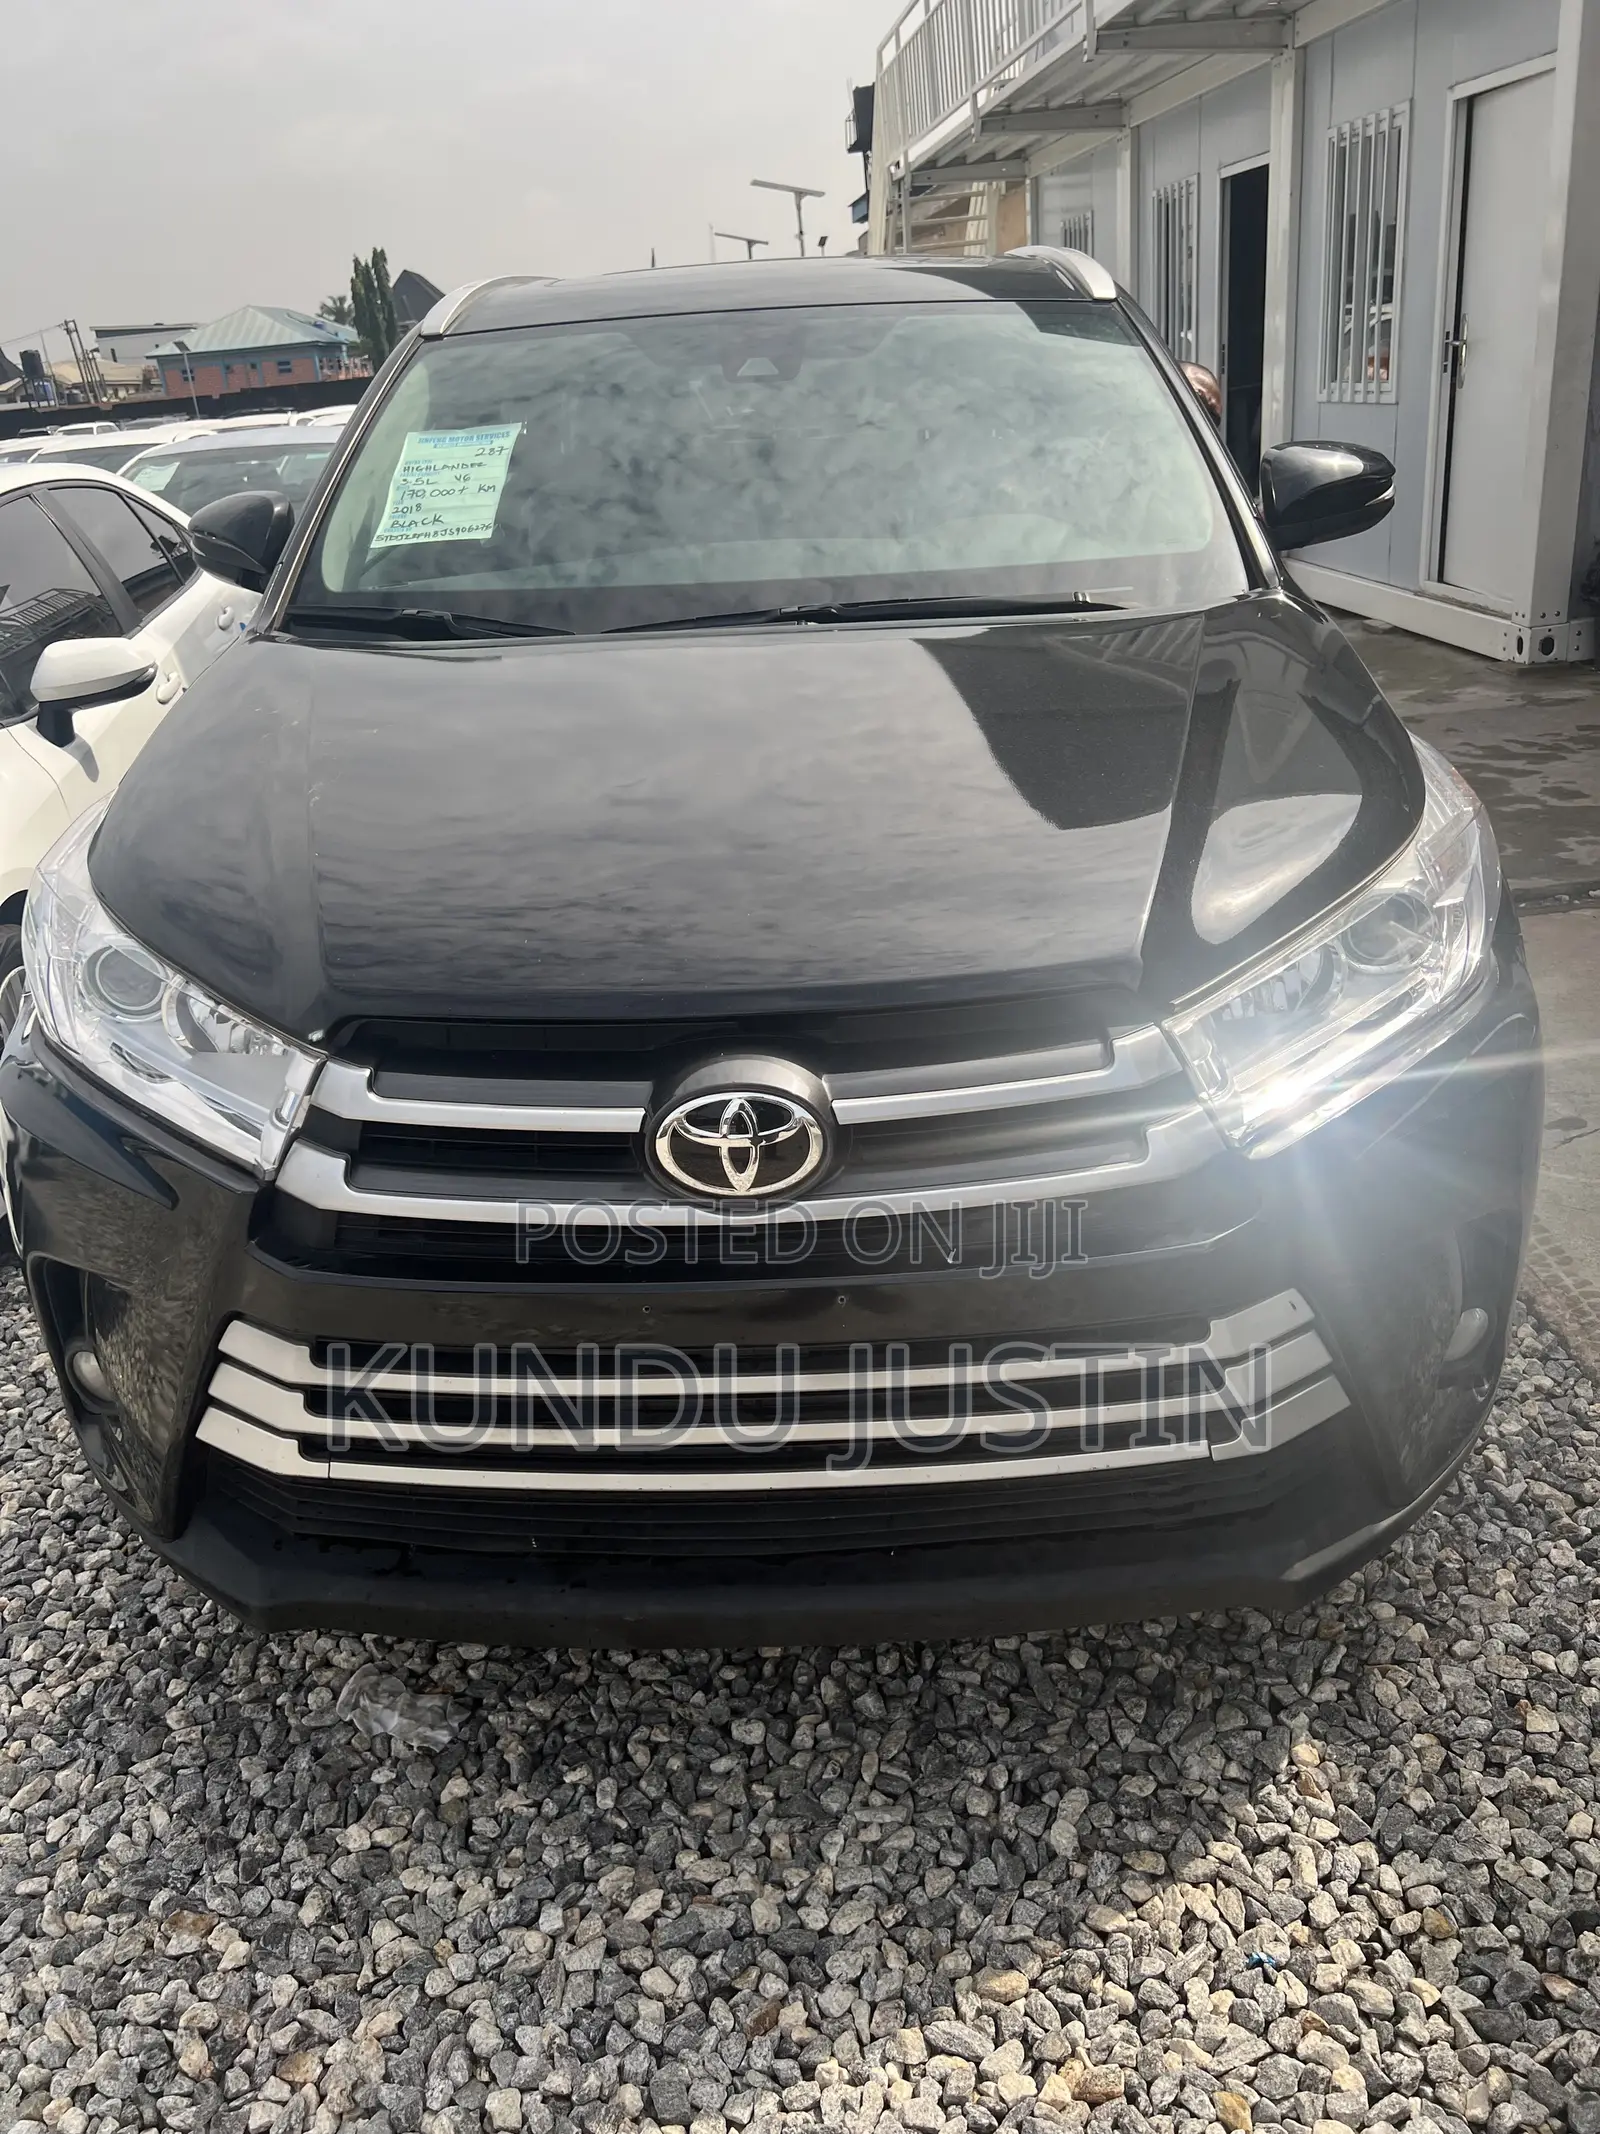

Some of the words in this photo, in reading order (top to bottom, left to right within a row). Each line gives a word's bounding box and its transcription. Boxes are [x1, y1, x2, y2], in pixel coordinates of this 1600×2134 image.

[448, 434, 473, 443] MOTOR
[474, 431, 511, 442] SERVICES
[474, 446, 509, 457] 287
[403, 463, 487, 473] HIGHLANDER
[454, 474, 471, 482] V6
[477, 484, 496, 493] KM
[391, 503, 422, 515] 2018
[390, 514, 445, 529] BLACK
